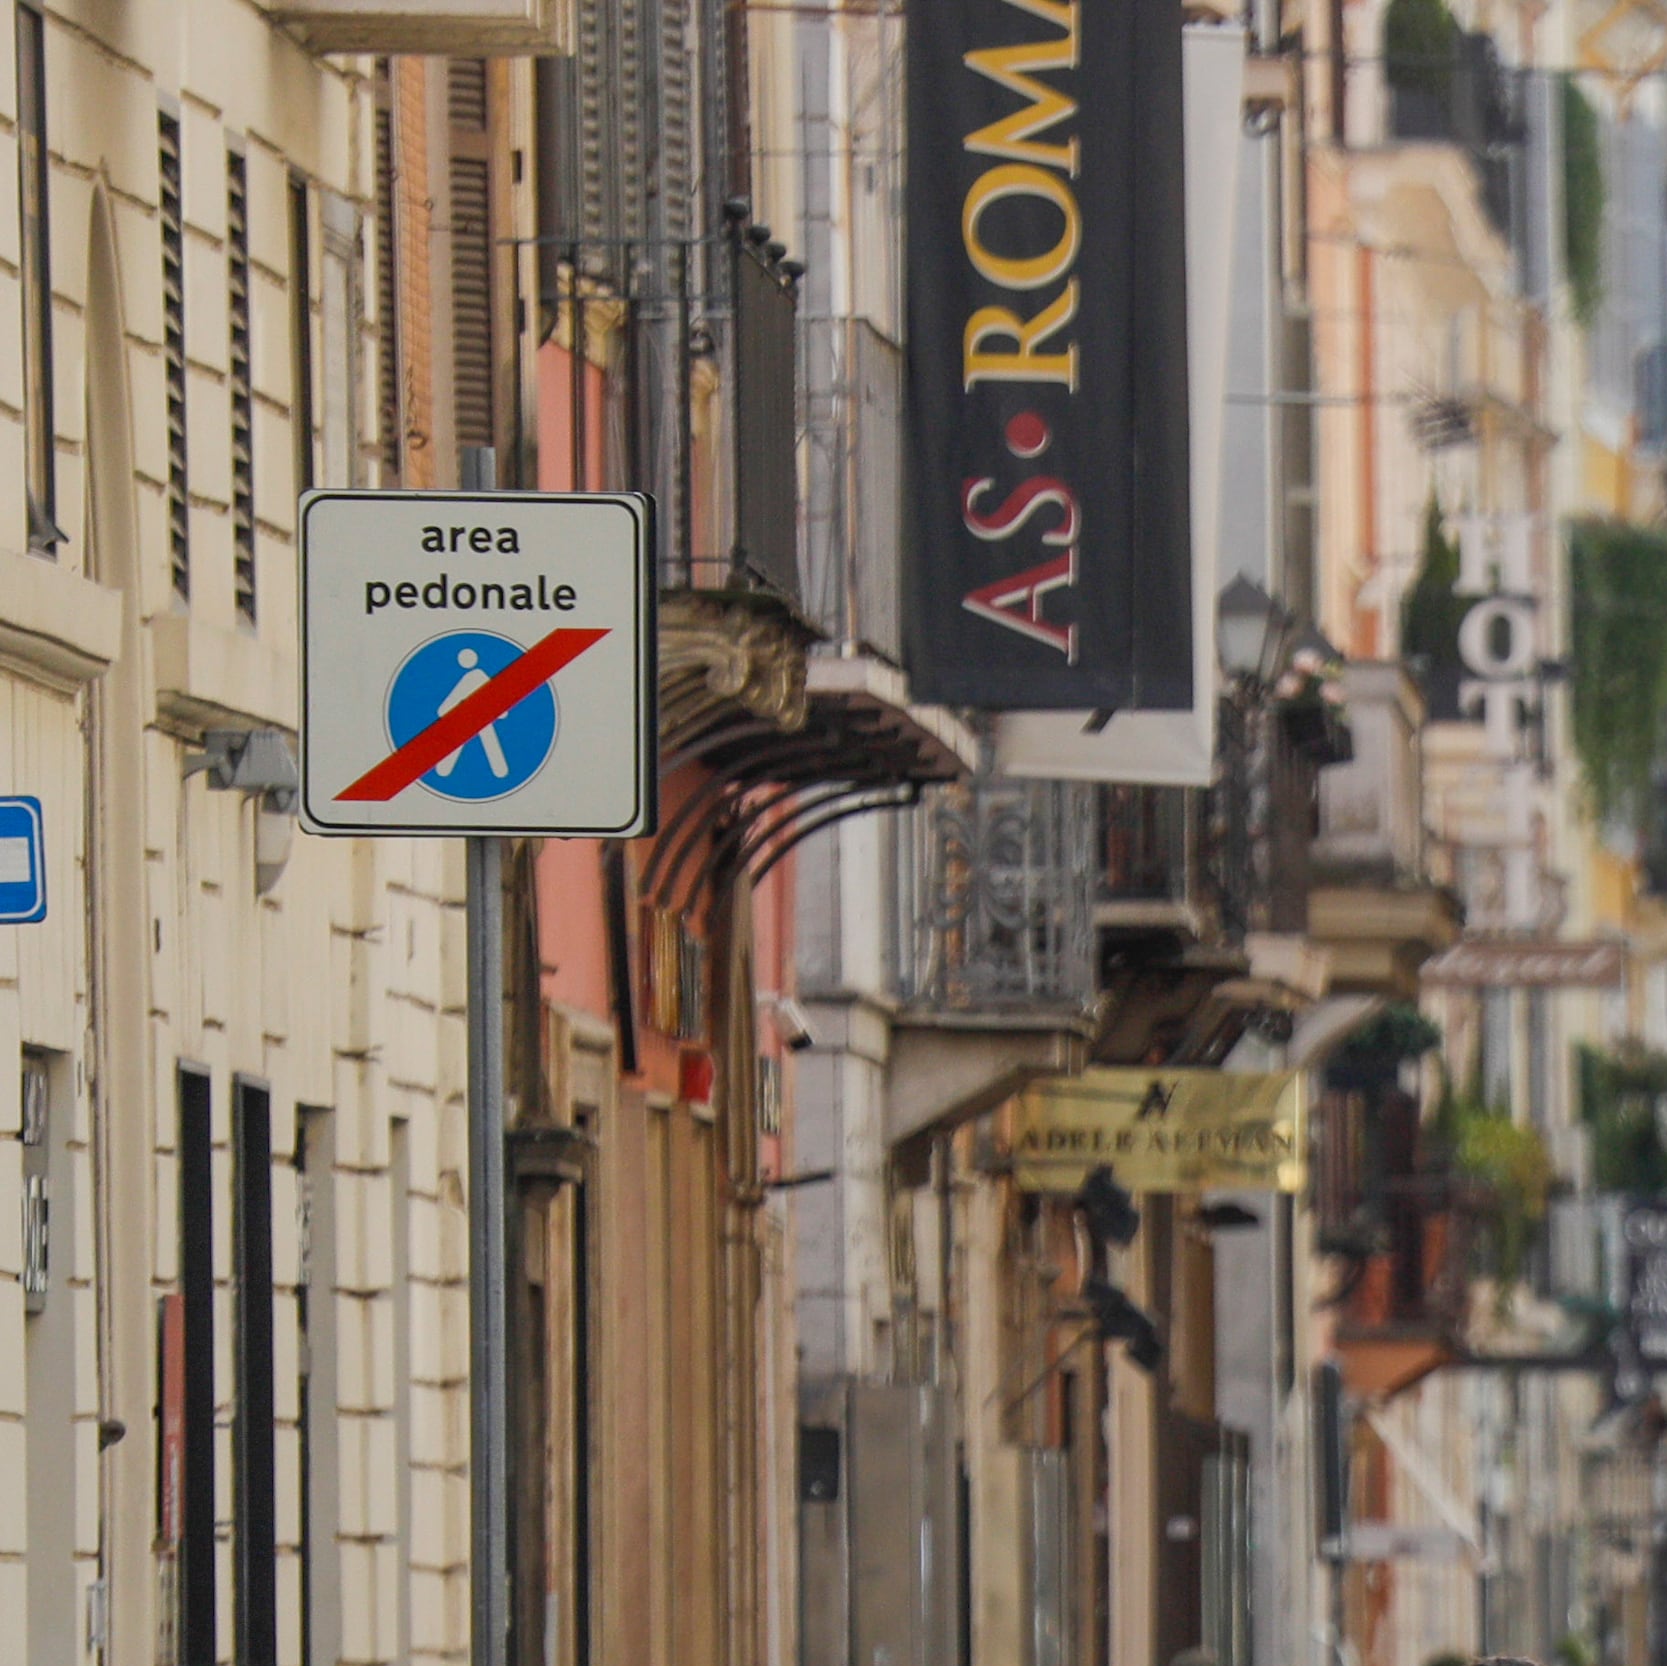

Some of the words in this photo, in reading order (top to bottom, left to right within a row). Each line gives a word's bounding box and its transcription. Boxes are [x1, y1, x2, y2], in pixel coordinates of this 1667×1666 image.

[420, 525, 520, 554] area
[961, 476, 1081, 667] AS
[365, 572, 578, 614] pedonale
